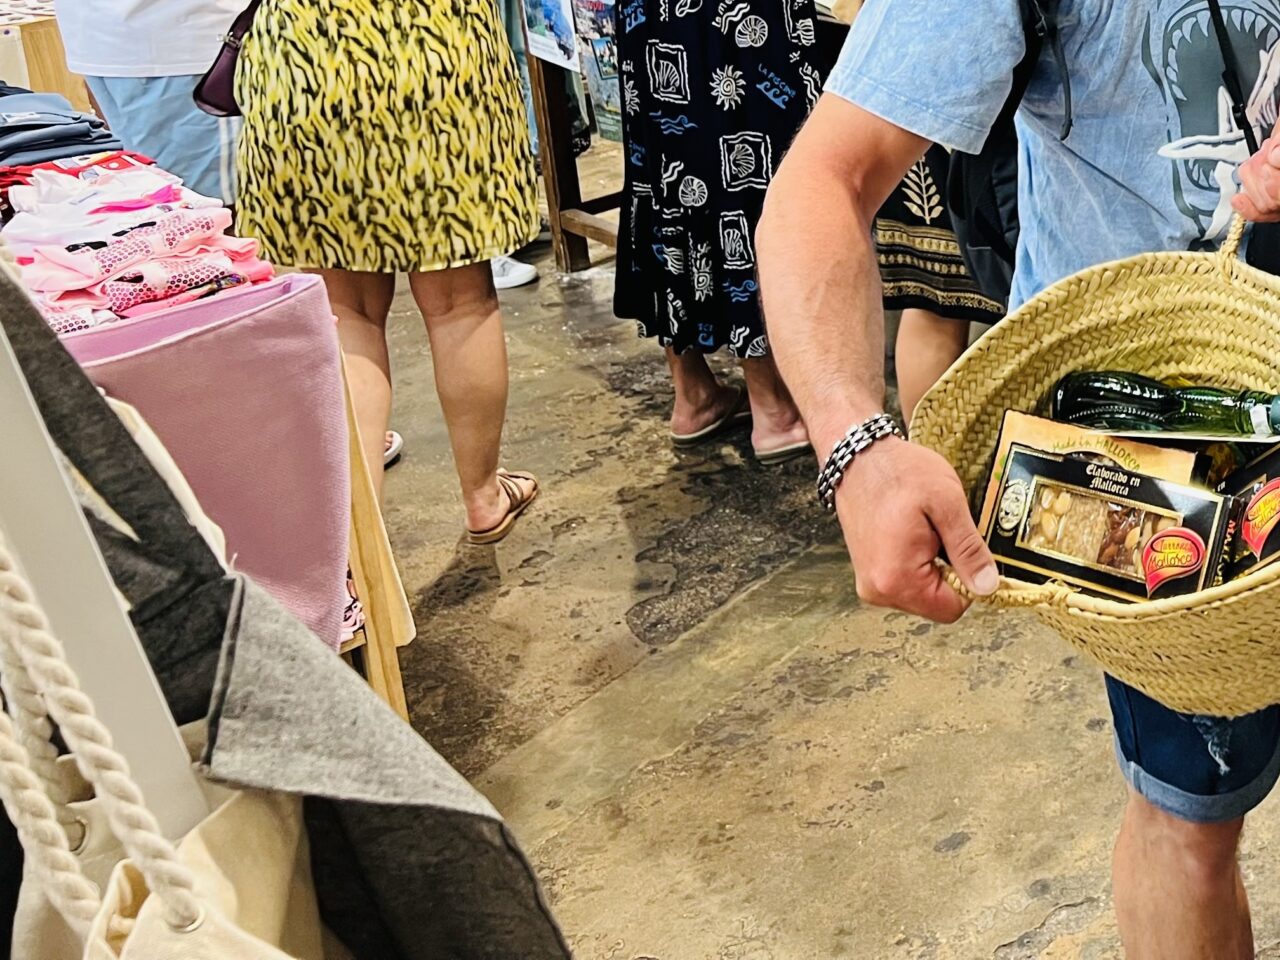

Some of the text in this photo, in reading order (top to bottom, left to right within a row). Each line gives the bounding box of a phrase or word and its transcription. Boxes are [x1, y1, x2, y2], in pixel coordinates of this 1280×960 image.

[1085, 463, 1141, 488] Elaborado en
[1089, 476, 1129, 496] Mallorca
